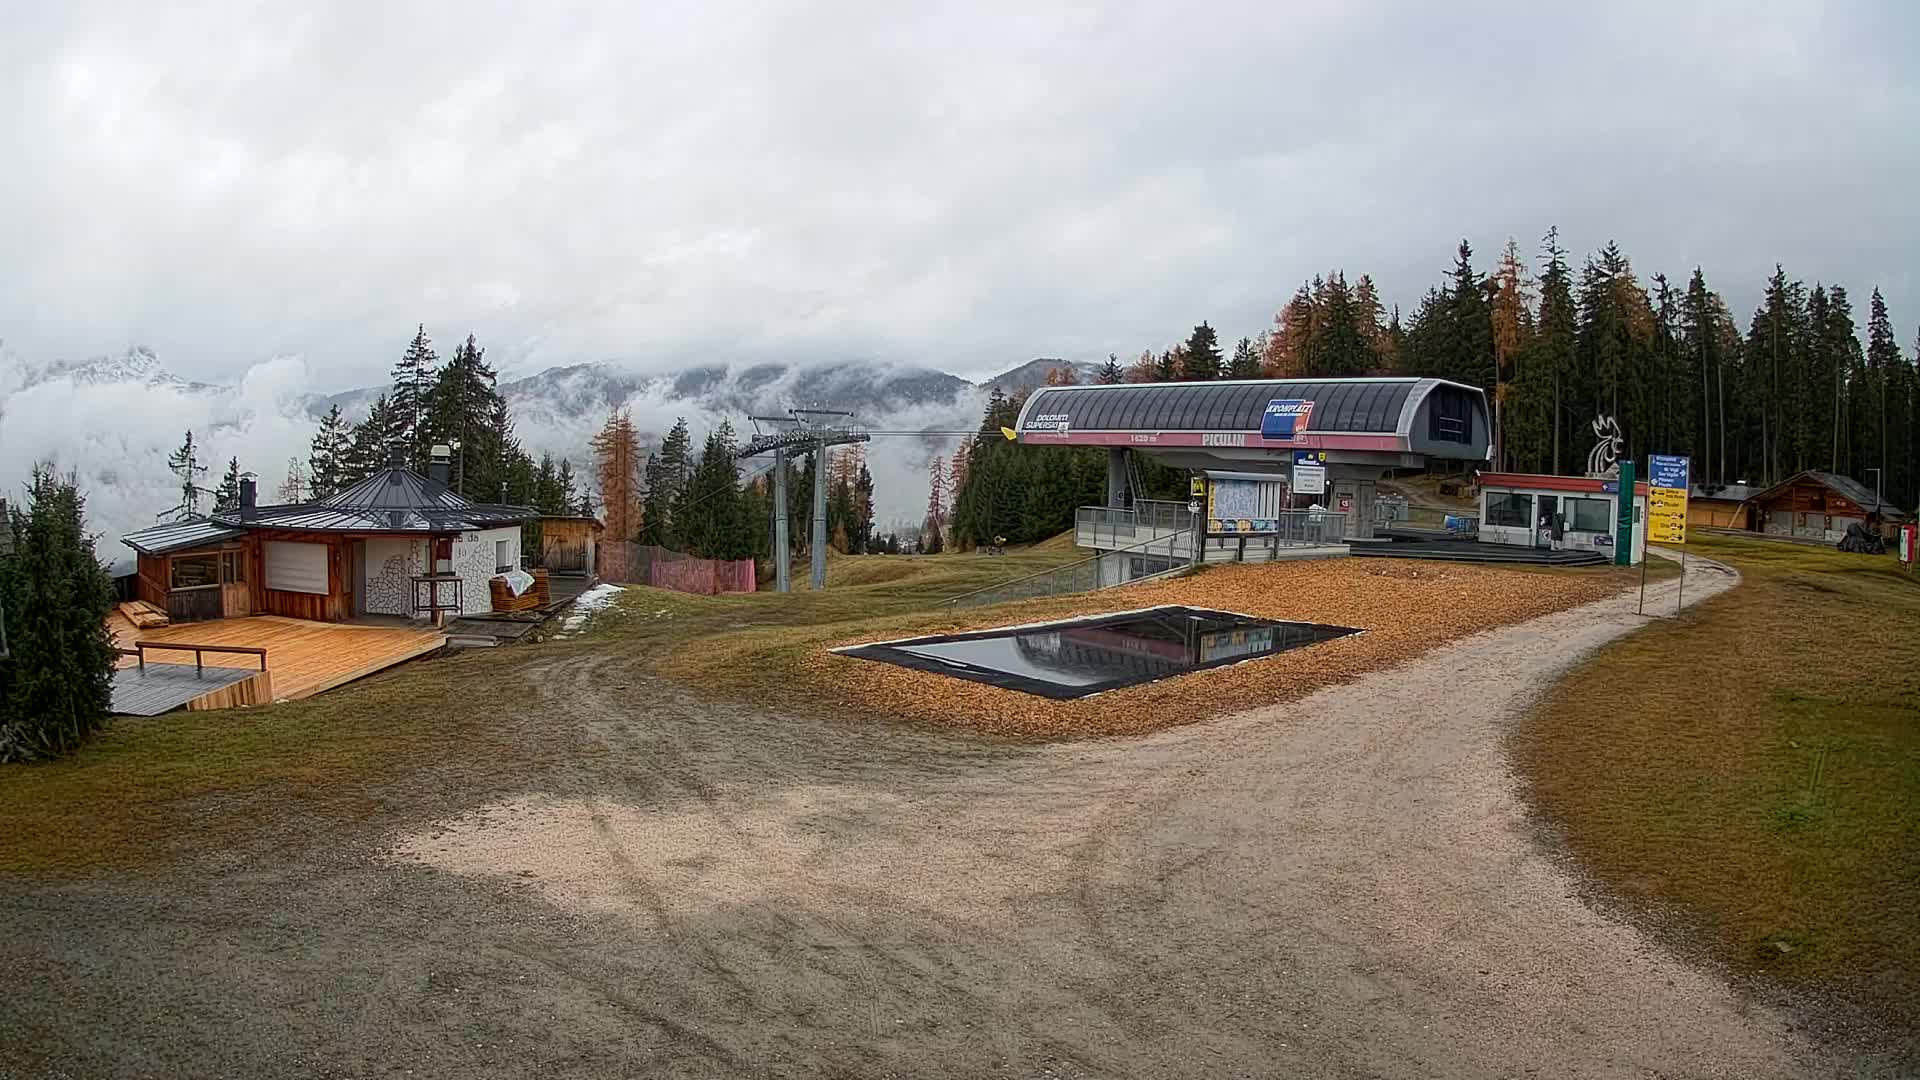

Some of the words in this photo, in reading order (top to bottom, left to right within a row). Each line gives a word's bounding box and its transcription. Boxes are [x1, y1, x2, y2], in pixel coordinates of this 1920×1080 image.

[1265, 404, 1312, 413] KRONPLATZ
[1025, 421, 1059, 429] SUPERSKI
[1202, 433, 1245, 446] PICULIN
